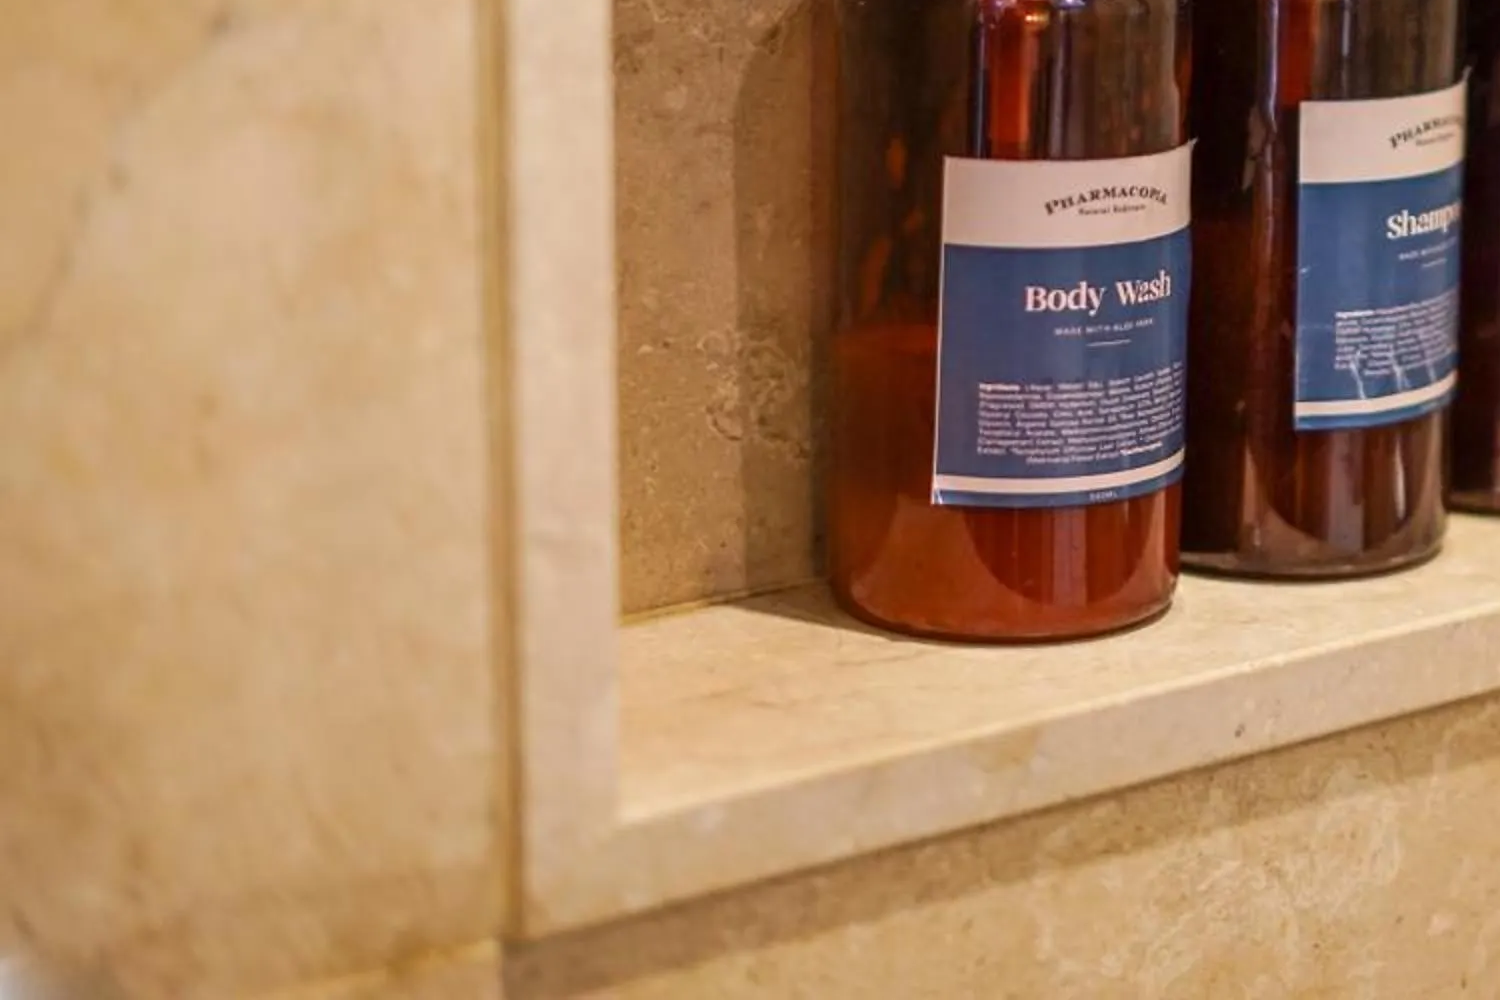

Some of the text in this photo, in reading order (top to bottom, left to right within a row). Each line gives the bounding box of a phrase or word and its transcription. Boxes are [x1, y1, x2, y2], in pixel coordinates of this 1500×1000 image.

[1044, 184, 1168, 216] PHARMACOPIA
[1024, 269, 1172, 316] Body Wash
